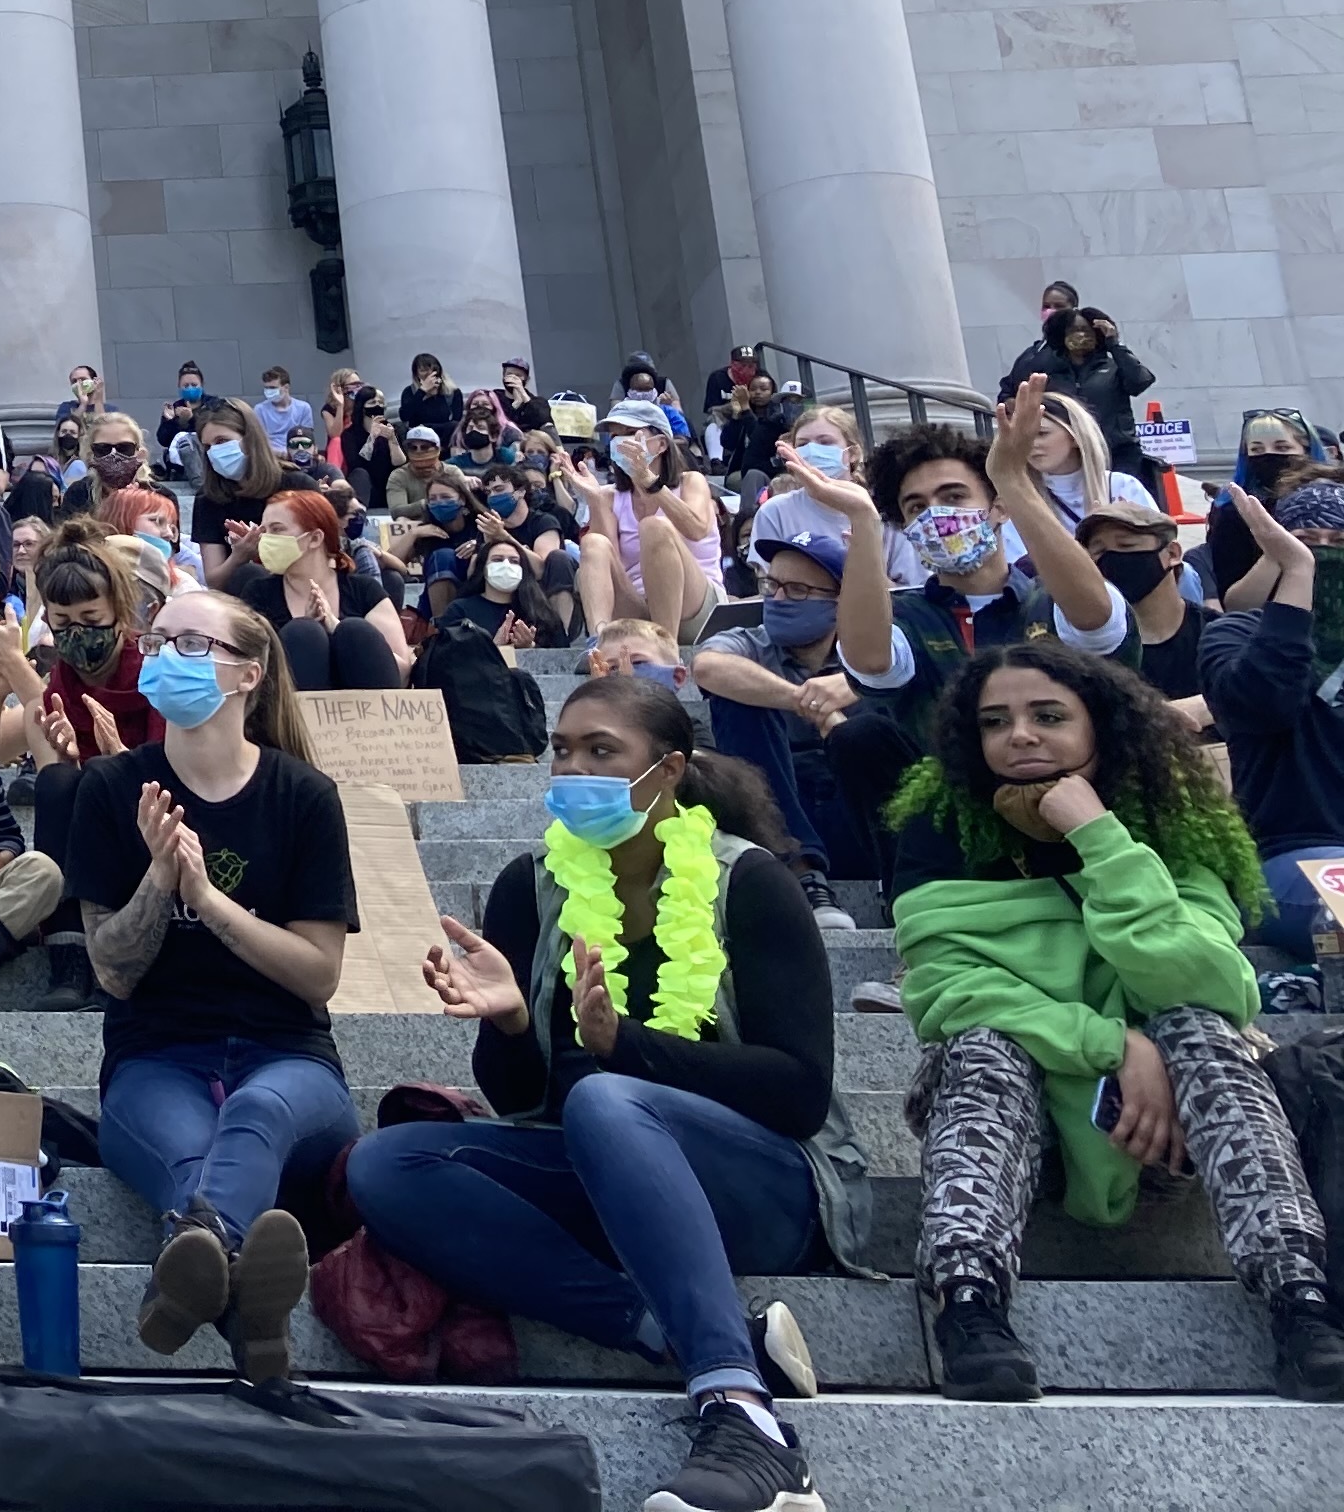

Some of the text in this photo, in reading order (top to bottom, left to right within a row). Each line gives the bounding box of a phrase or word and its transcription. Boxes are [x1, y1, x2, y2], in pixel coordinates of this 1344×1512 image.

[1135, 422, 1184, 437] NOTICE
[306, 694, 444, 726] THEIR NAMES
